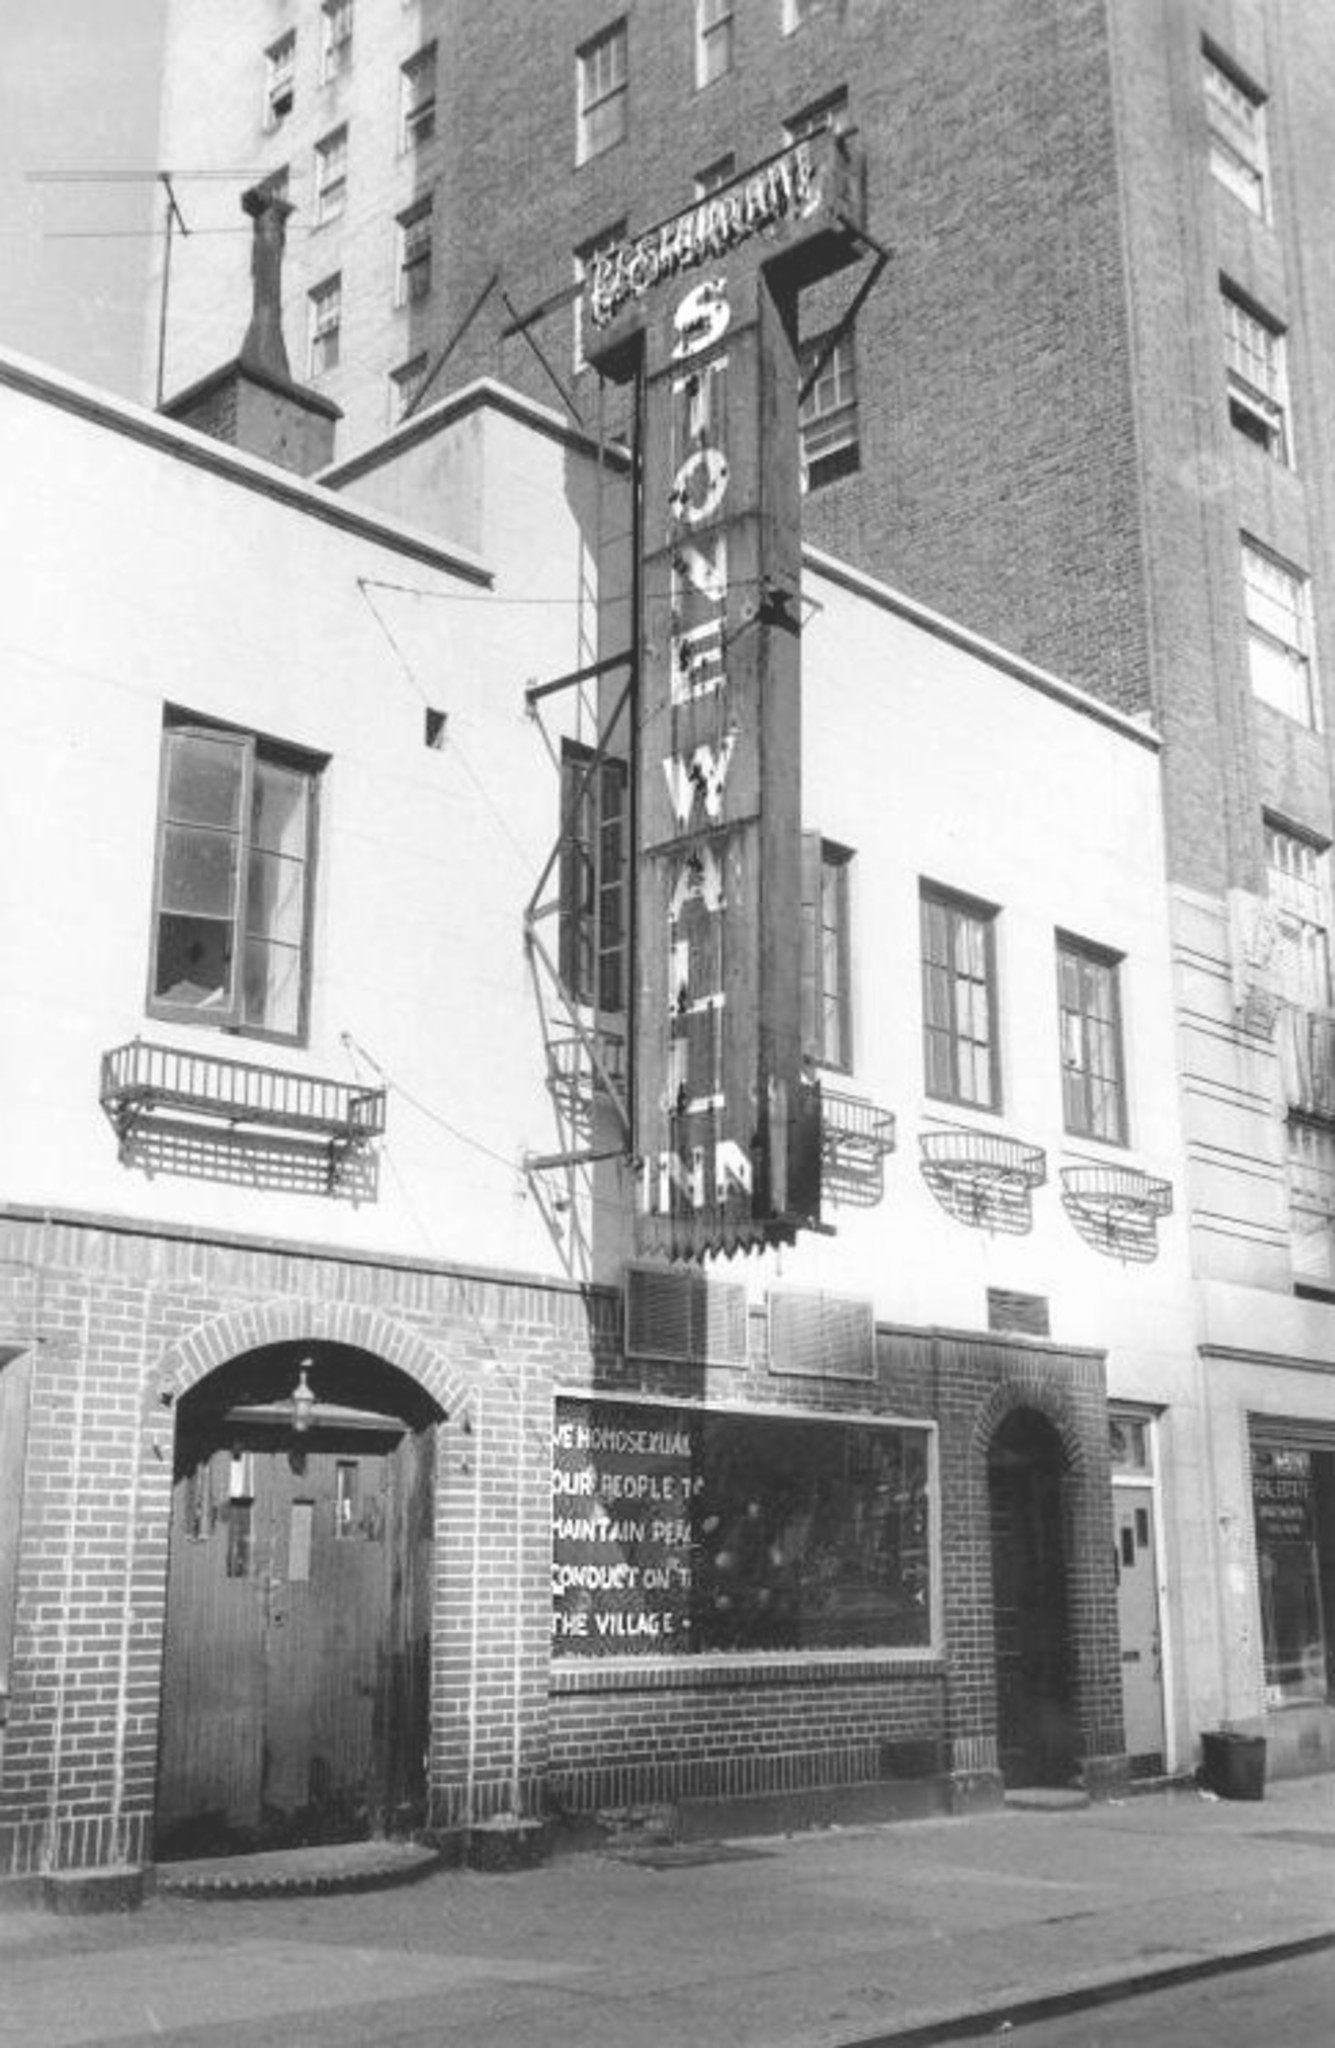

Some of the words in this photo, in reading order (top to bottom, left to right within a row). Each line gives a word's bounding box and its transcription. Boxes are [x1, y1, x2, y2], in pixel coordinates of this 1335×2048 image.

[642, 1139, 754, 1215] INN
[552, 1469, 593, 1496] OUR
[602, 1474, 674, 1500] PEOPLE
[551, 1563, 639, 1592] CONDUCT
[644, 1567, 670, 1590] ON
[552, 1612, 588, 1637] THE
[594, 1612, 674, 1636] VILLAGE
